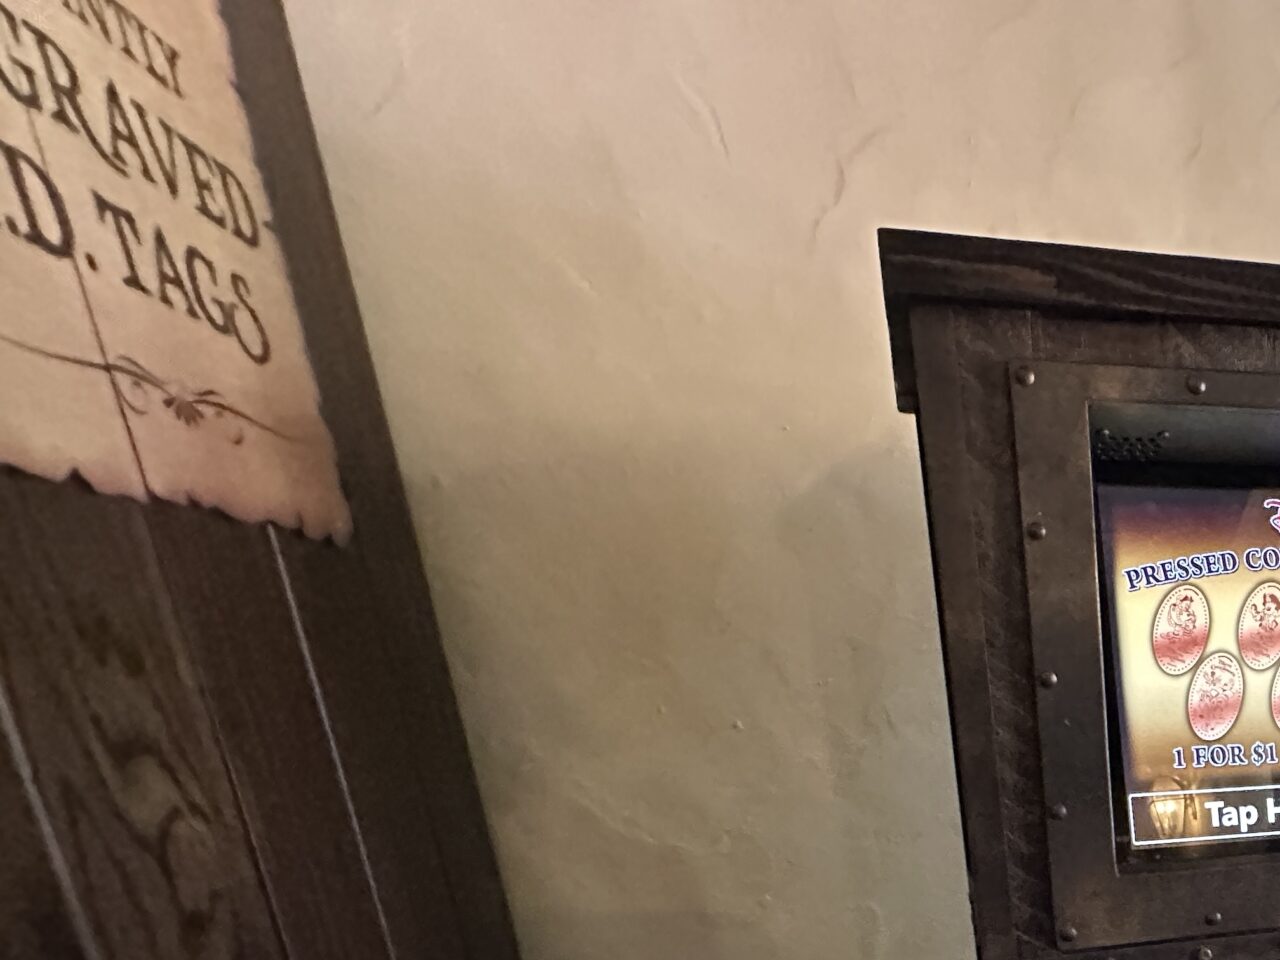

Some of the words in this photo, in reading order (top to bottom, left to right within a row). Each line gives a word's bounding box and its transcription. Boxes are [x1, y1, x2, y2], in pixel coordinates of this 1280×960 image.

[90, 188, 270, 365] TAGS
[1124, 551, 1239, 591] PRESSED
[1173, 747, 1186, 768] 1
[1192, 744, 1248, 768] FOR
[1251, 741, 1278, 766] $1
[1204, 800, 1258, 832] Tap
